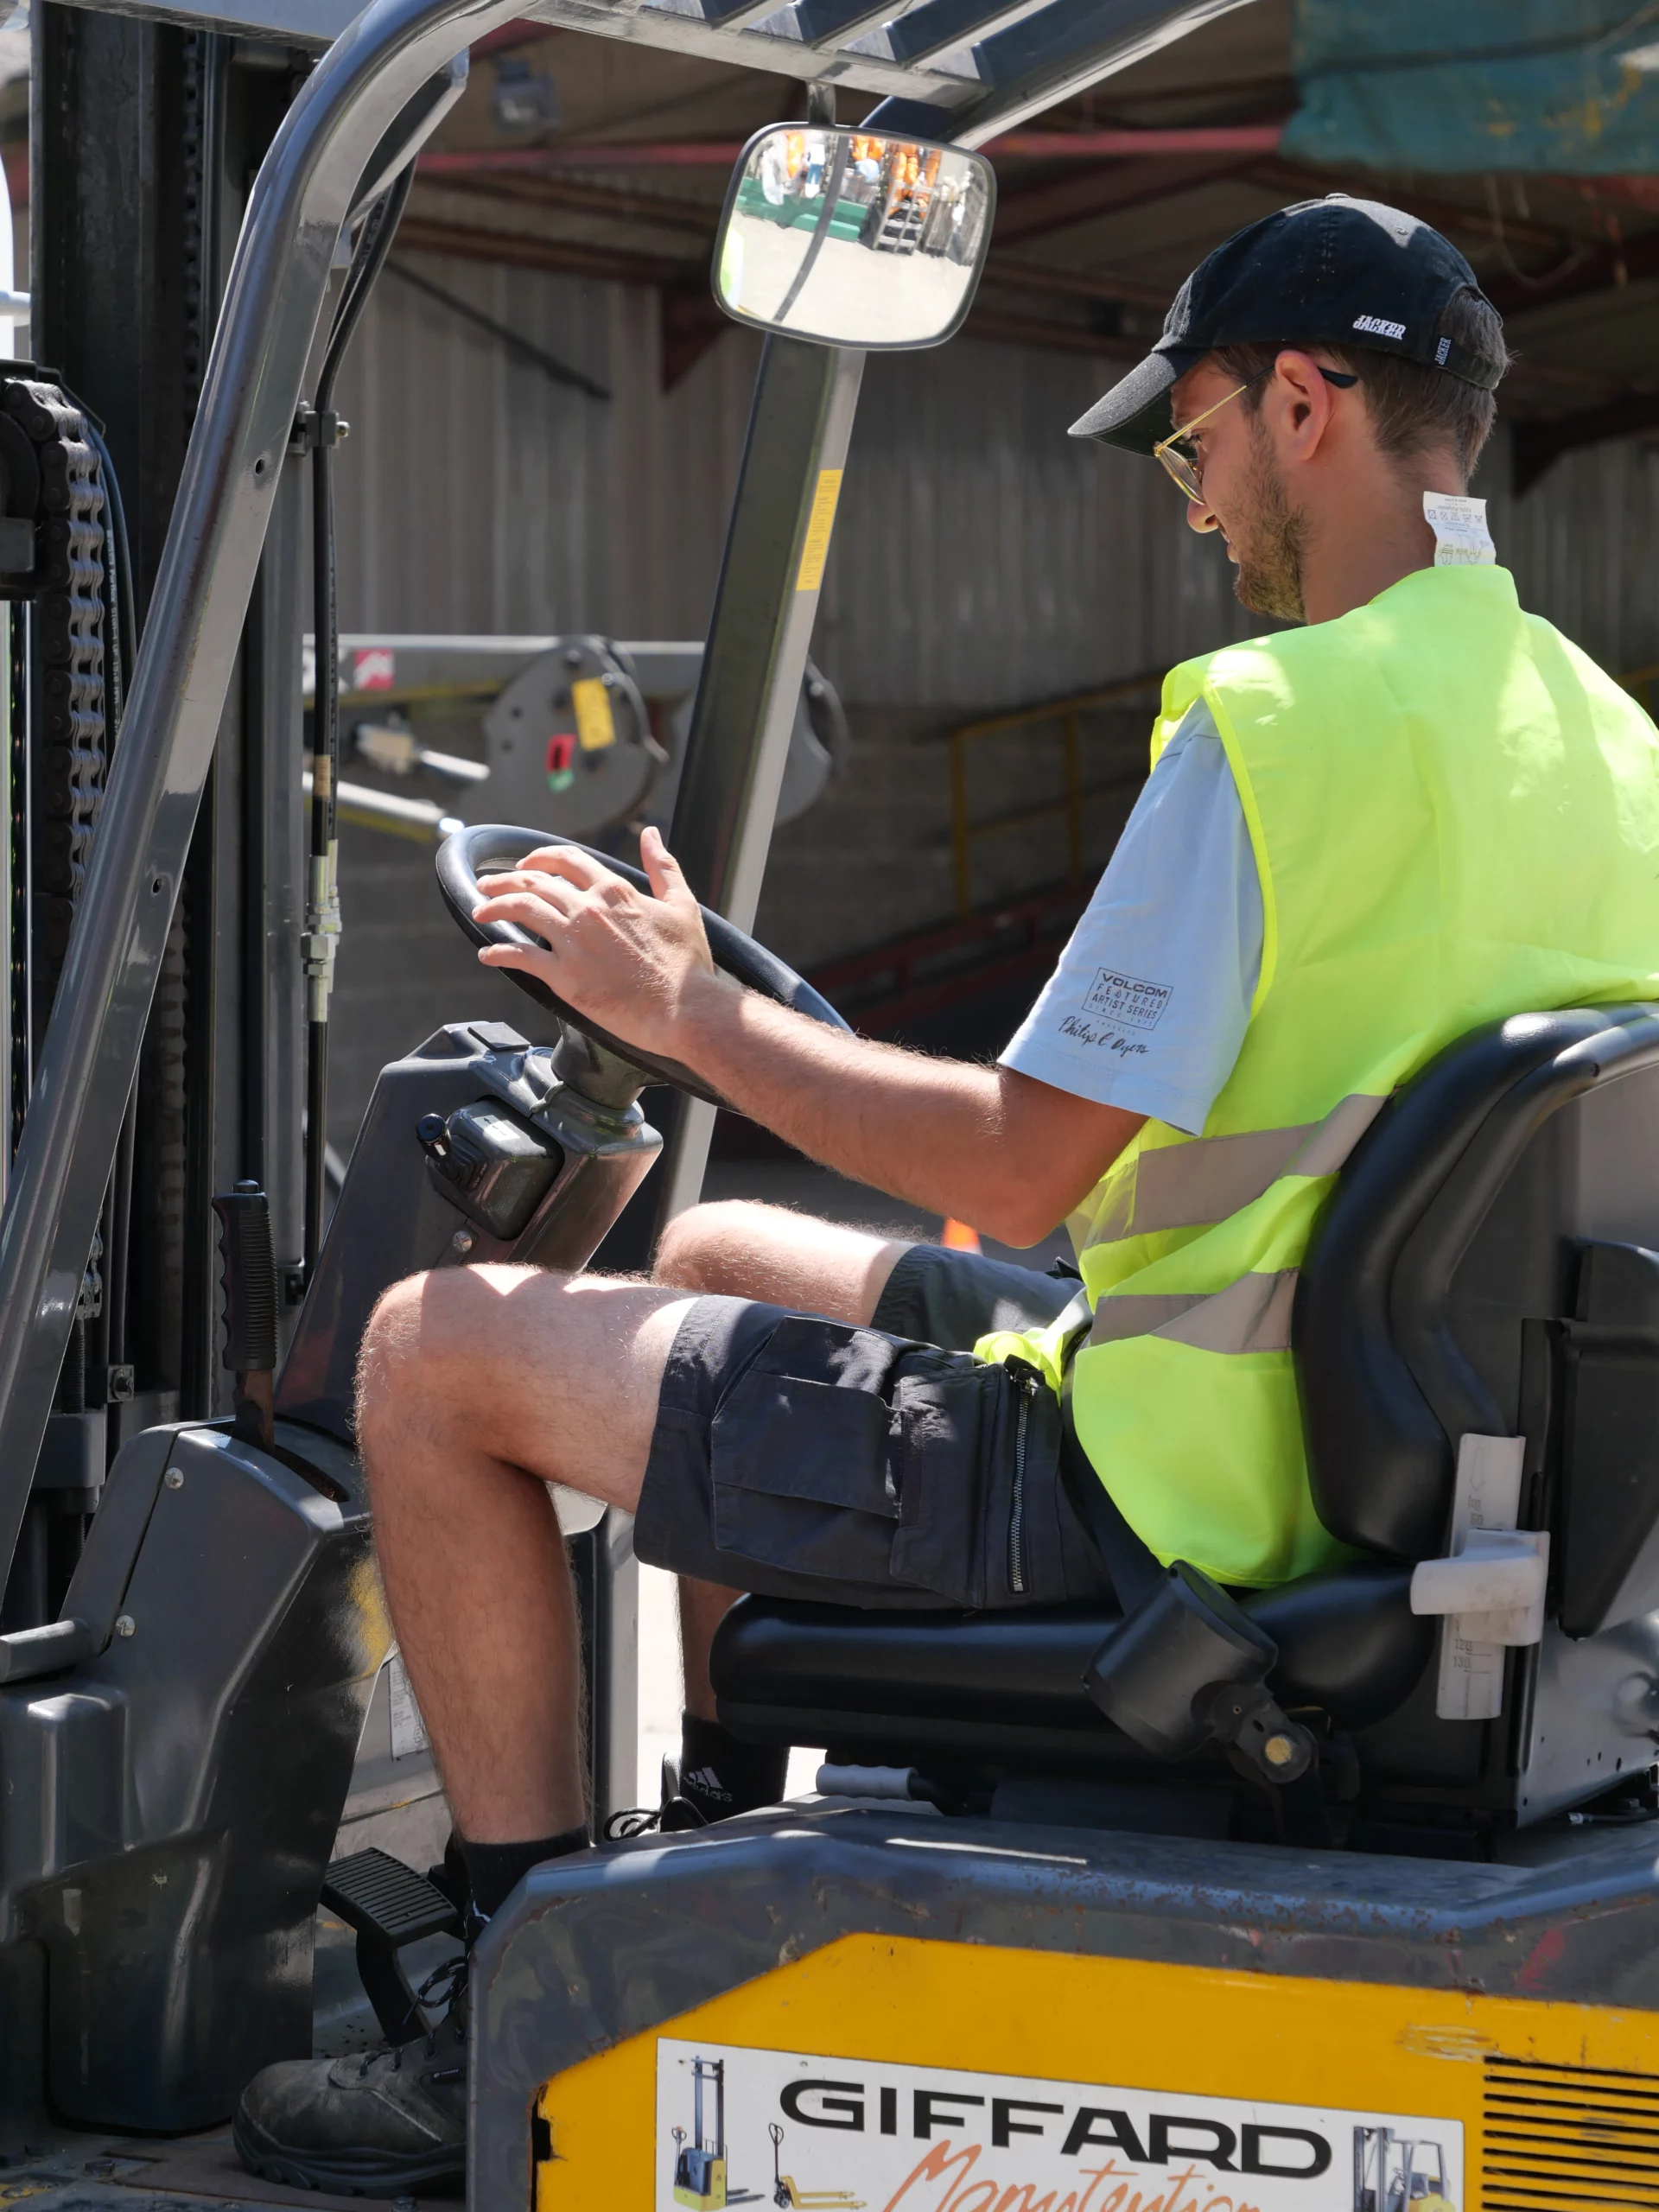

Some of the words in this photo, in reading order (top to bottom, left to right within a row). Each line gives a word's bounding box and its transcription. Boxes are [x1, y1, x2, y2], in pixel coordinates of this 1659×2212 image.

[1352, 315, 1407, 340] JACKER
[1434, 337, 1452, 365] JACKER
[1103, 973, 1168, 998] VOLCOM
[1092, 994, 1125, 1009] ARTIST
[1127, 1005, 1158, 1020] SERIES
[1469, 1495, 1482, 1511] kg
[779, 2079, 1332, 2179] GIFFARD
[882, 2139, 1260, 2212] Manutenti
